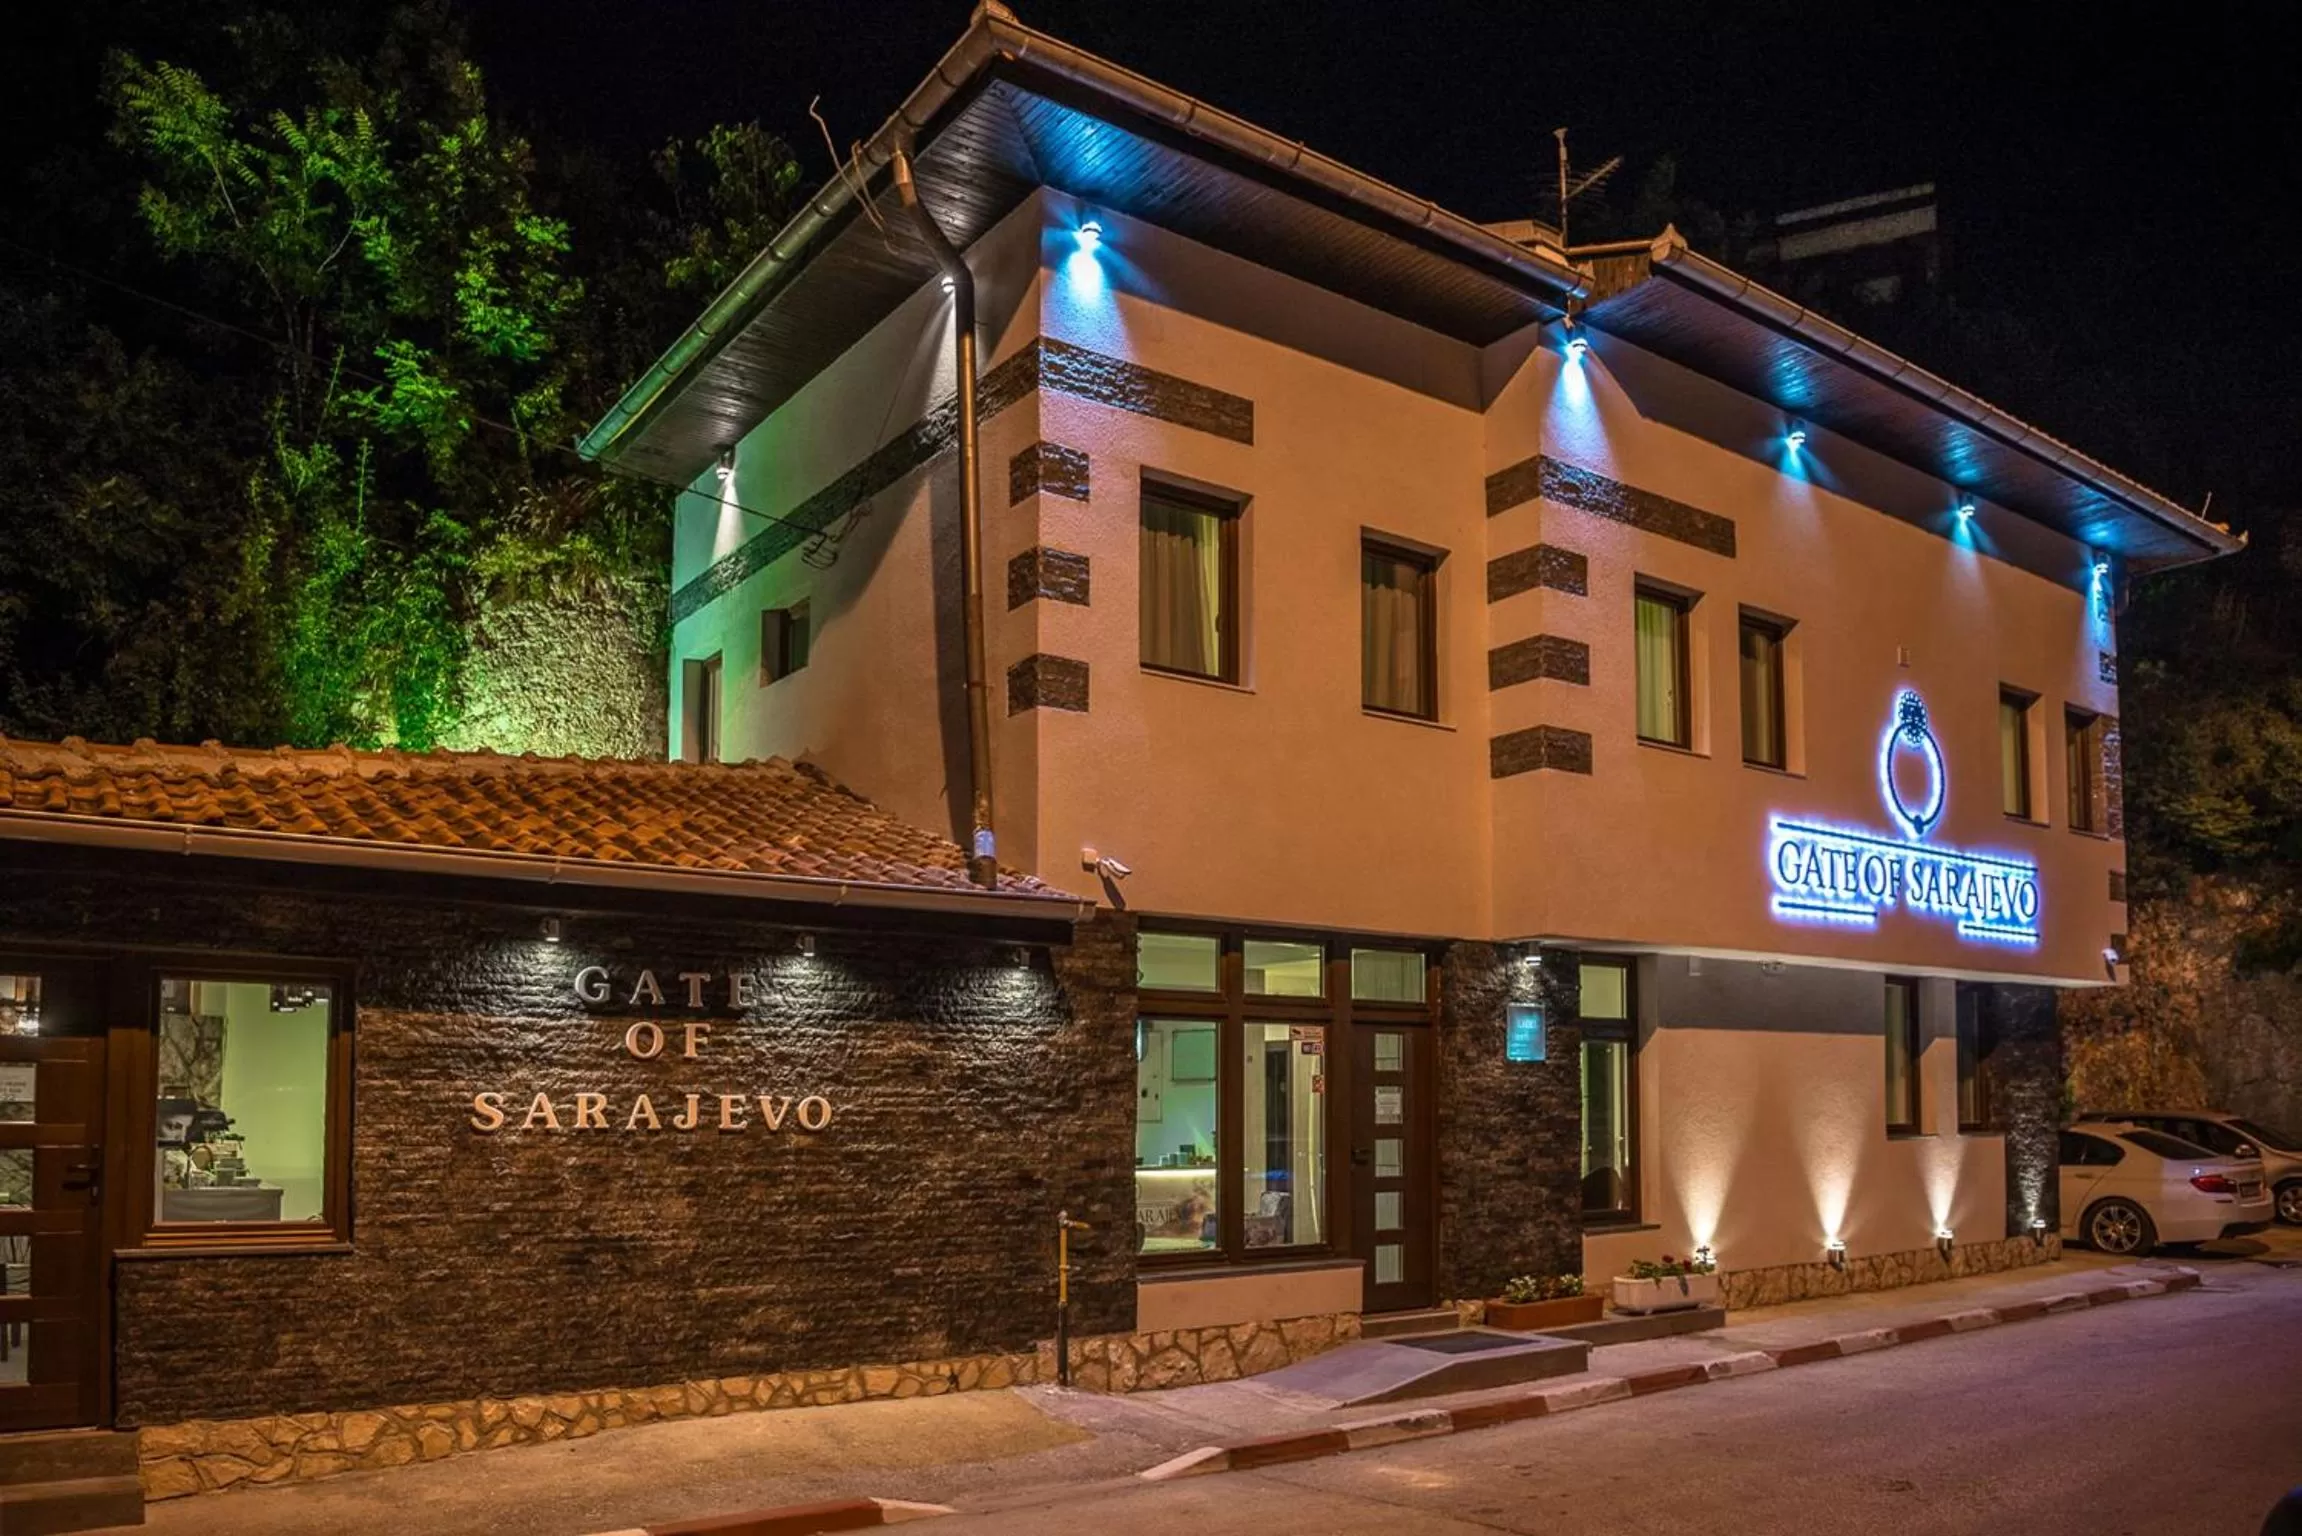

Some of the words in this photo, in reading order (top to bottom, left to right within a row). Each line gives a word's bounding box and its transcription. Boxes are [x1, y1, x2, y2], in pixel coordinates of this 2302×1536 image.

[1778, 840, 1858, 893] GATE
[1864, 855, 1901, 899] OF
[1911, 861, 2038, 920] SARAJEVO
[575, 966, 757, 1010] GATE
[625, 1021, 712, 1059] OF
[471, 1091, 833, 1132] SARAJEVO
